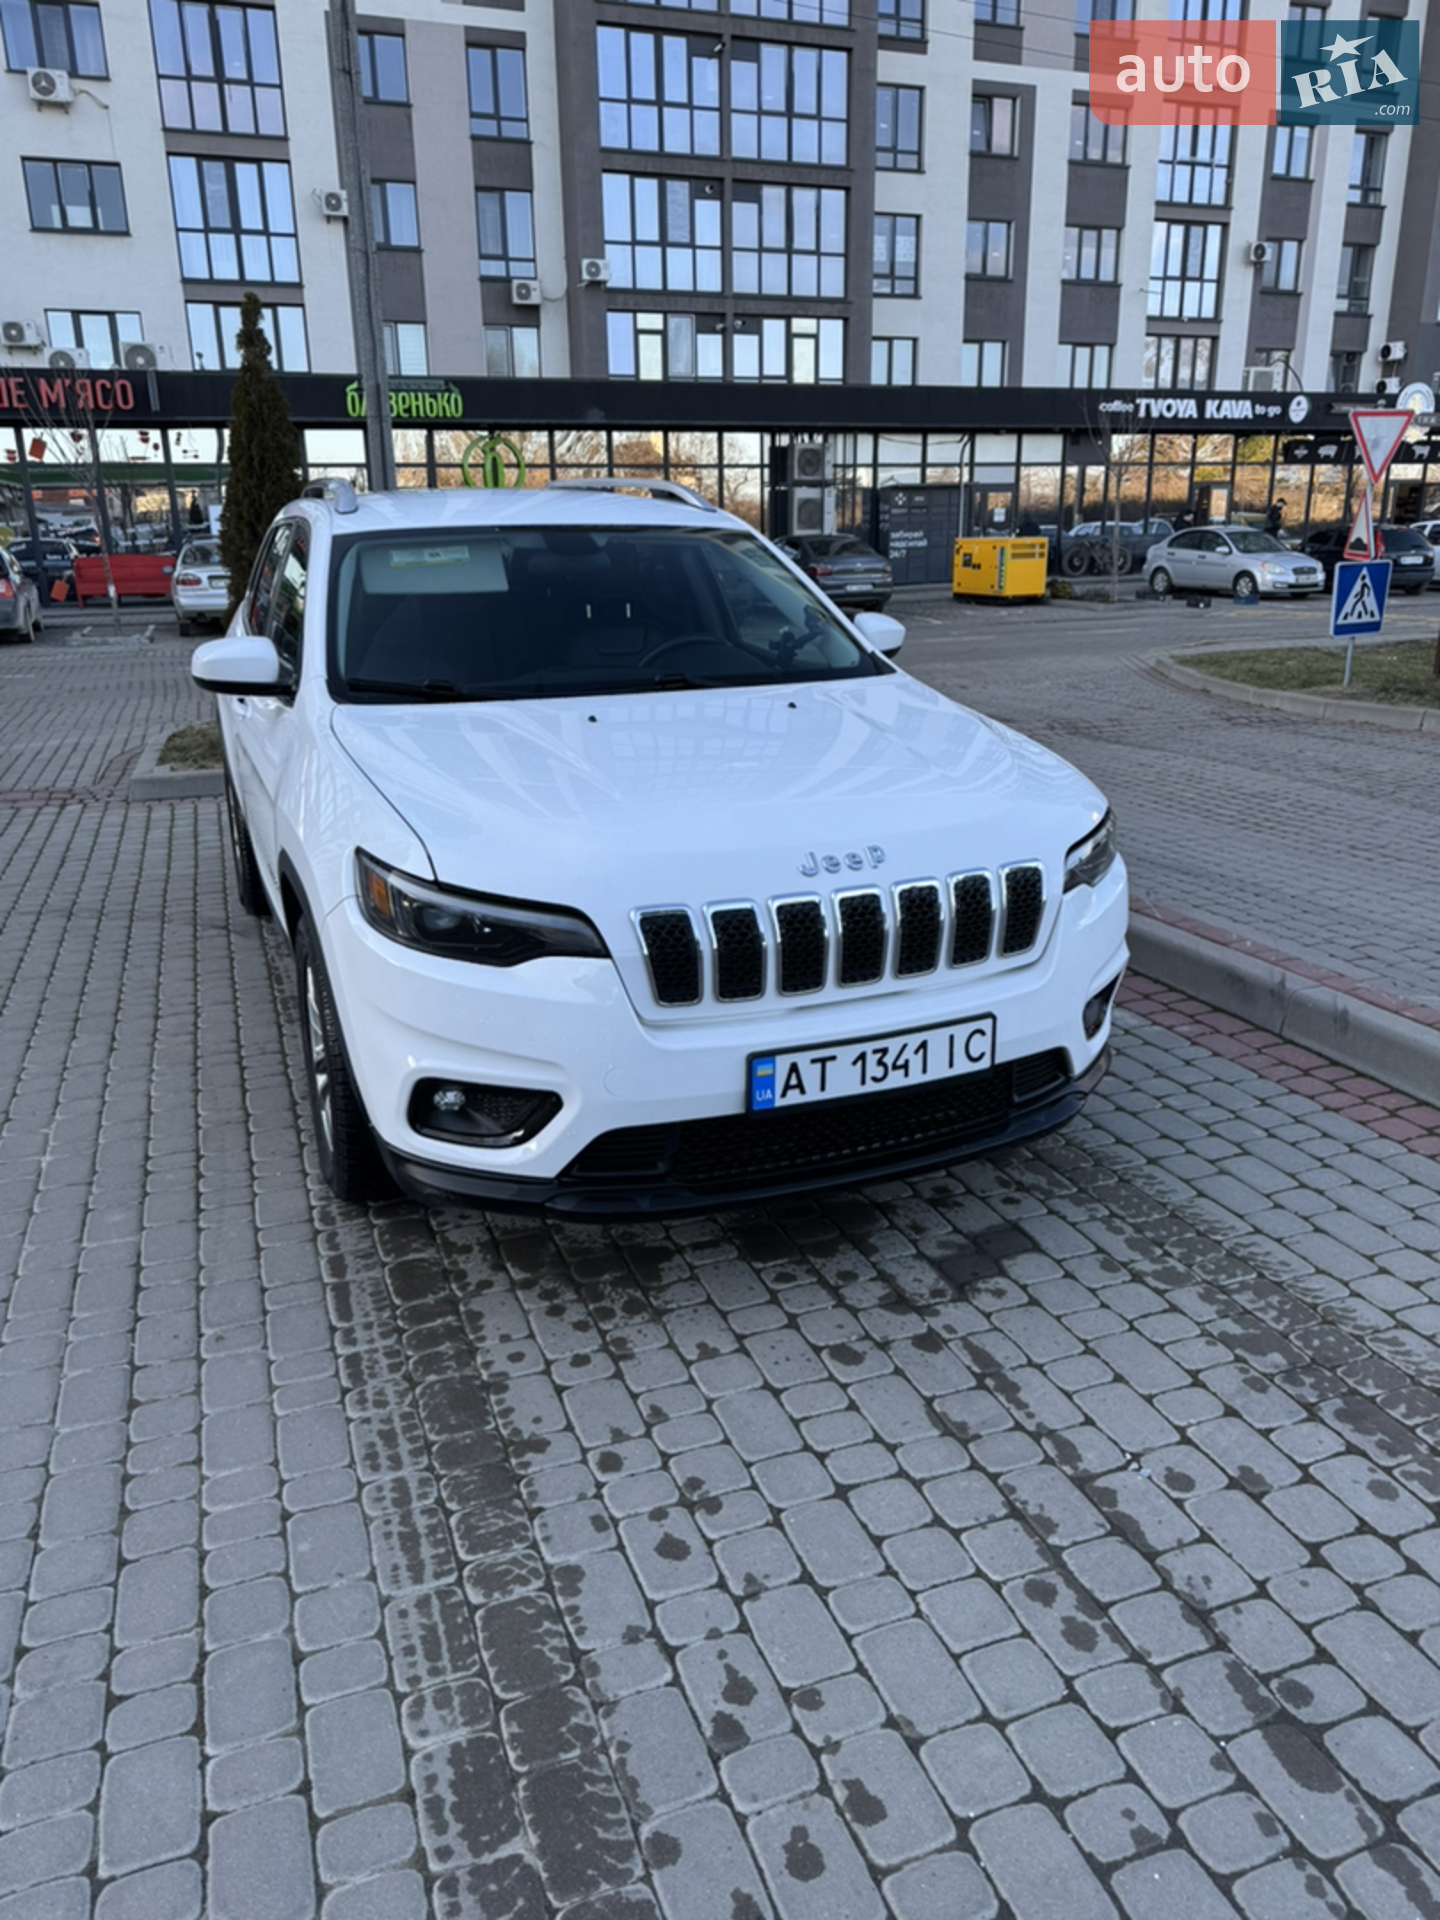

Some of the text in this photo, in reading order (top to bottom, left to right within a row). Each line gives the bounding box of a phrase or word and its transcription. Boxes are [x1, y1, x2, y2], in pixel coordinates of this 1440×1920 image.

[38, 377, 135, 410] М'ЯСО
[1098, 398, 1282, 419] coffee TVOYA KAVA to go
[799, 845, 887, 877] Jeep
[780, 1029, 988, 1099] AT 1341 IC
[755, 1088, 774, 1102] UA
